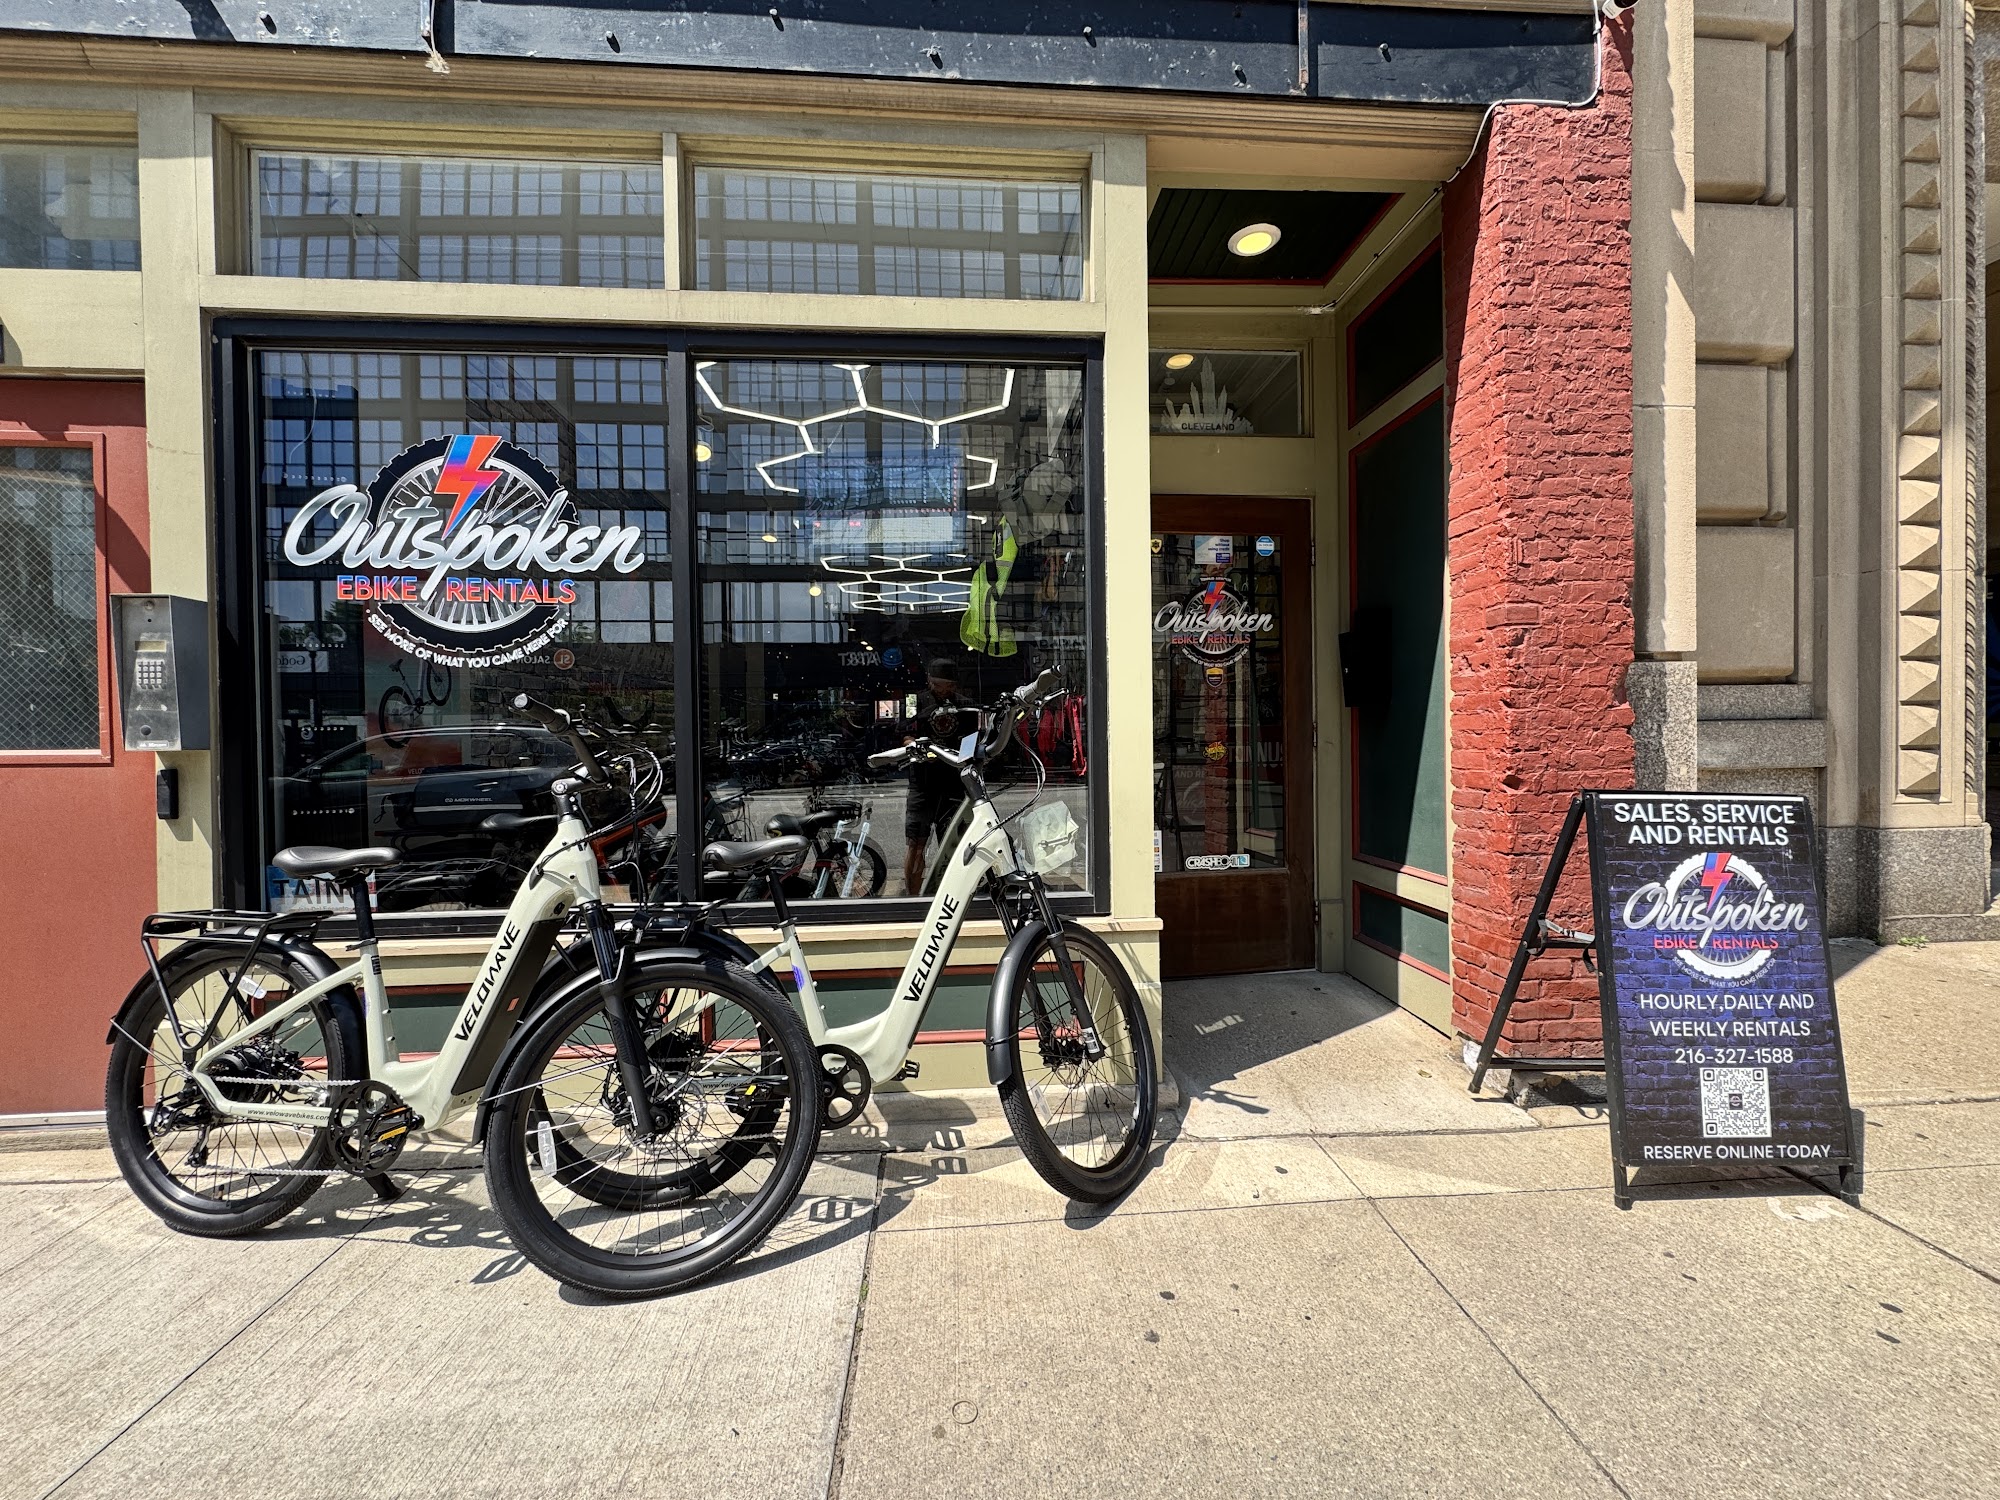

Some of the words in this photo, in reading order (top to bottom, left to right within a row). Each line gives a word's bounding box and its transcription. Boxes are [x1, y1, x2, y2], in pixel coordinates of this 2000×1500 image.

[1181, 422, 1235, 431] CLEVELAND
[284, 484, 645, 601] Outspoken
[336, 575, 417, 602] EBIKE
[446, 576, 576, 604] RENTALS
[1154, 601, 1274, 643] Outspoken
[368, 613, 385, 633] SEE
[384, 629, 416, 654] MORE
[415, 646, 433, 660] OF
[433, 652, 465, 668] WHAT
[465, 656, 490, 668] YOU
[492, 649, 524, 666] CAME
[523, 633, 550, 655] HERE
[548, 618, 569, 638] FOR
[1171, 634, 1199, 645] EBIKE
[1207, 633, 1251, 645] RENTALS
[1614, 803, 1697, 826] SALES,
[1702, 804, 1796, 824] SERVICE
[1628, 825, 1682, 845] AND
[1689, 826, 1789, 846] RENTALS
[1622, 882, 1808, 948] Outspoken
[903, 894, 959, 1002] VELOWAVE
[1654, 934, 1698, 949] EBIKE
[1712, 935, 1778, 949] RENTALS
[454, 920, 520, 1041] VELOWAVE
[1709, 978, 1726, 987] WHAT
[1779, 994, 1814, 1009] AND
[1650, 1021, 1728, 1037] WEEKLY
[1733, 1021, 1811, 1037] RENTALS
[1675, 1048, 1794, 1064] 216-327-1588
[1643, 1145, 1712, 1159] RESERVE
[1716, 1145, 1774, 1159] ONLINE
[1776, 1144, 1831, 1158] TODAY
